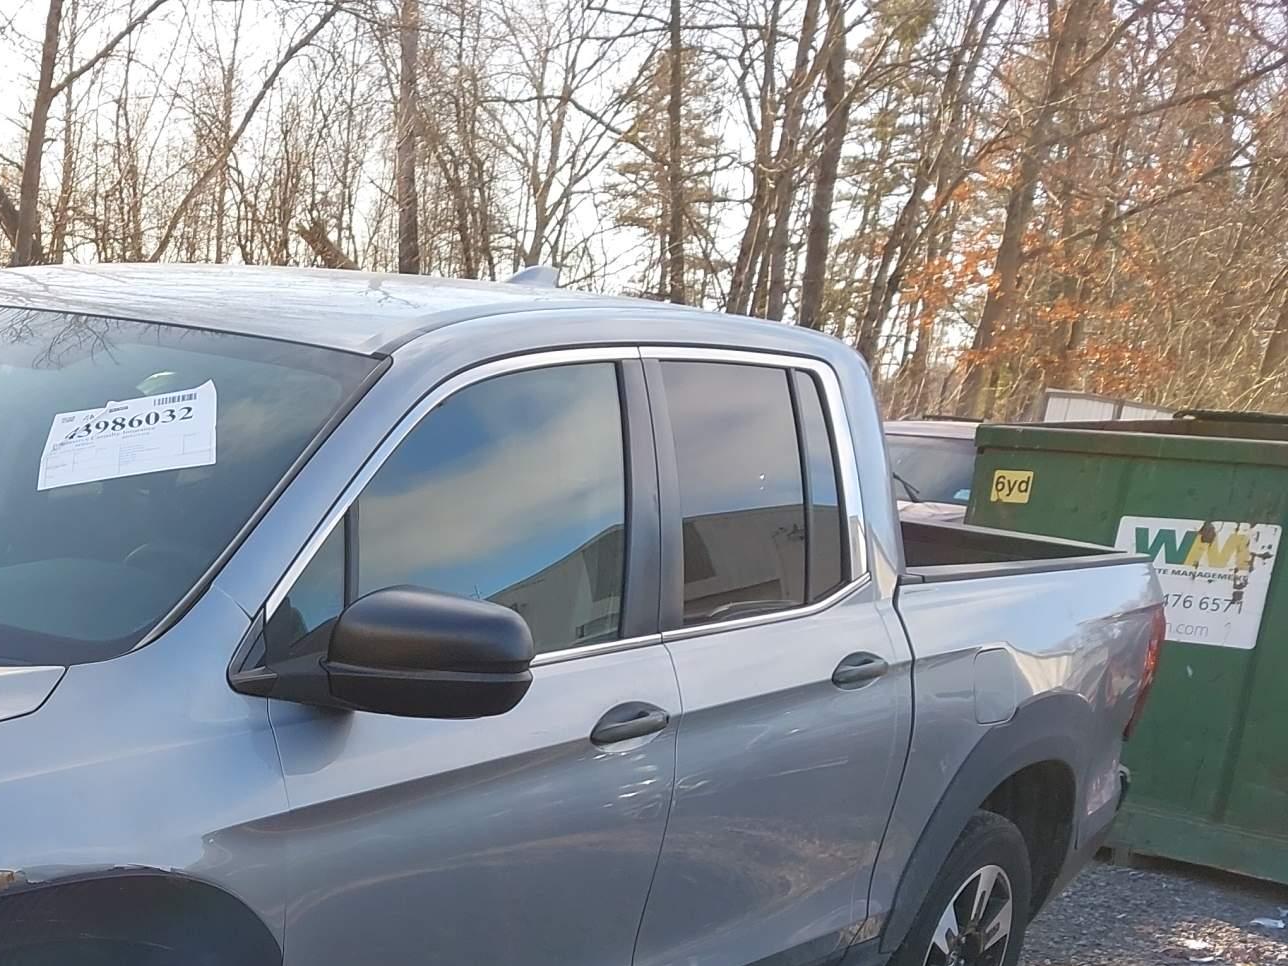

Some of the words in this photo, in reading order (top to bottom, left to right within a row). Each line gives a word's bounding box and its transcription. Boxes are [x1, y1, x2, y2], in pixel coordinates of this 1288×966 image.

[995, 475, 1031, 497] 6yd
[1135, 527, 1250, 571] WM
[1155, 568, 1169, 576] TE
[1198, 596, 1243, 615] 6571
